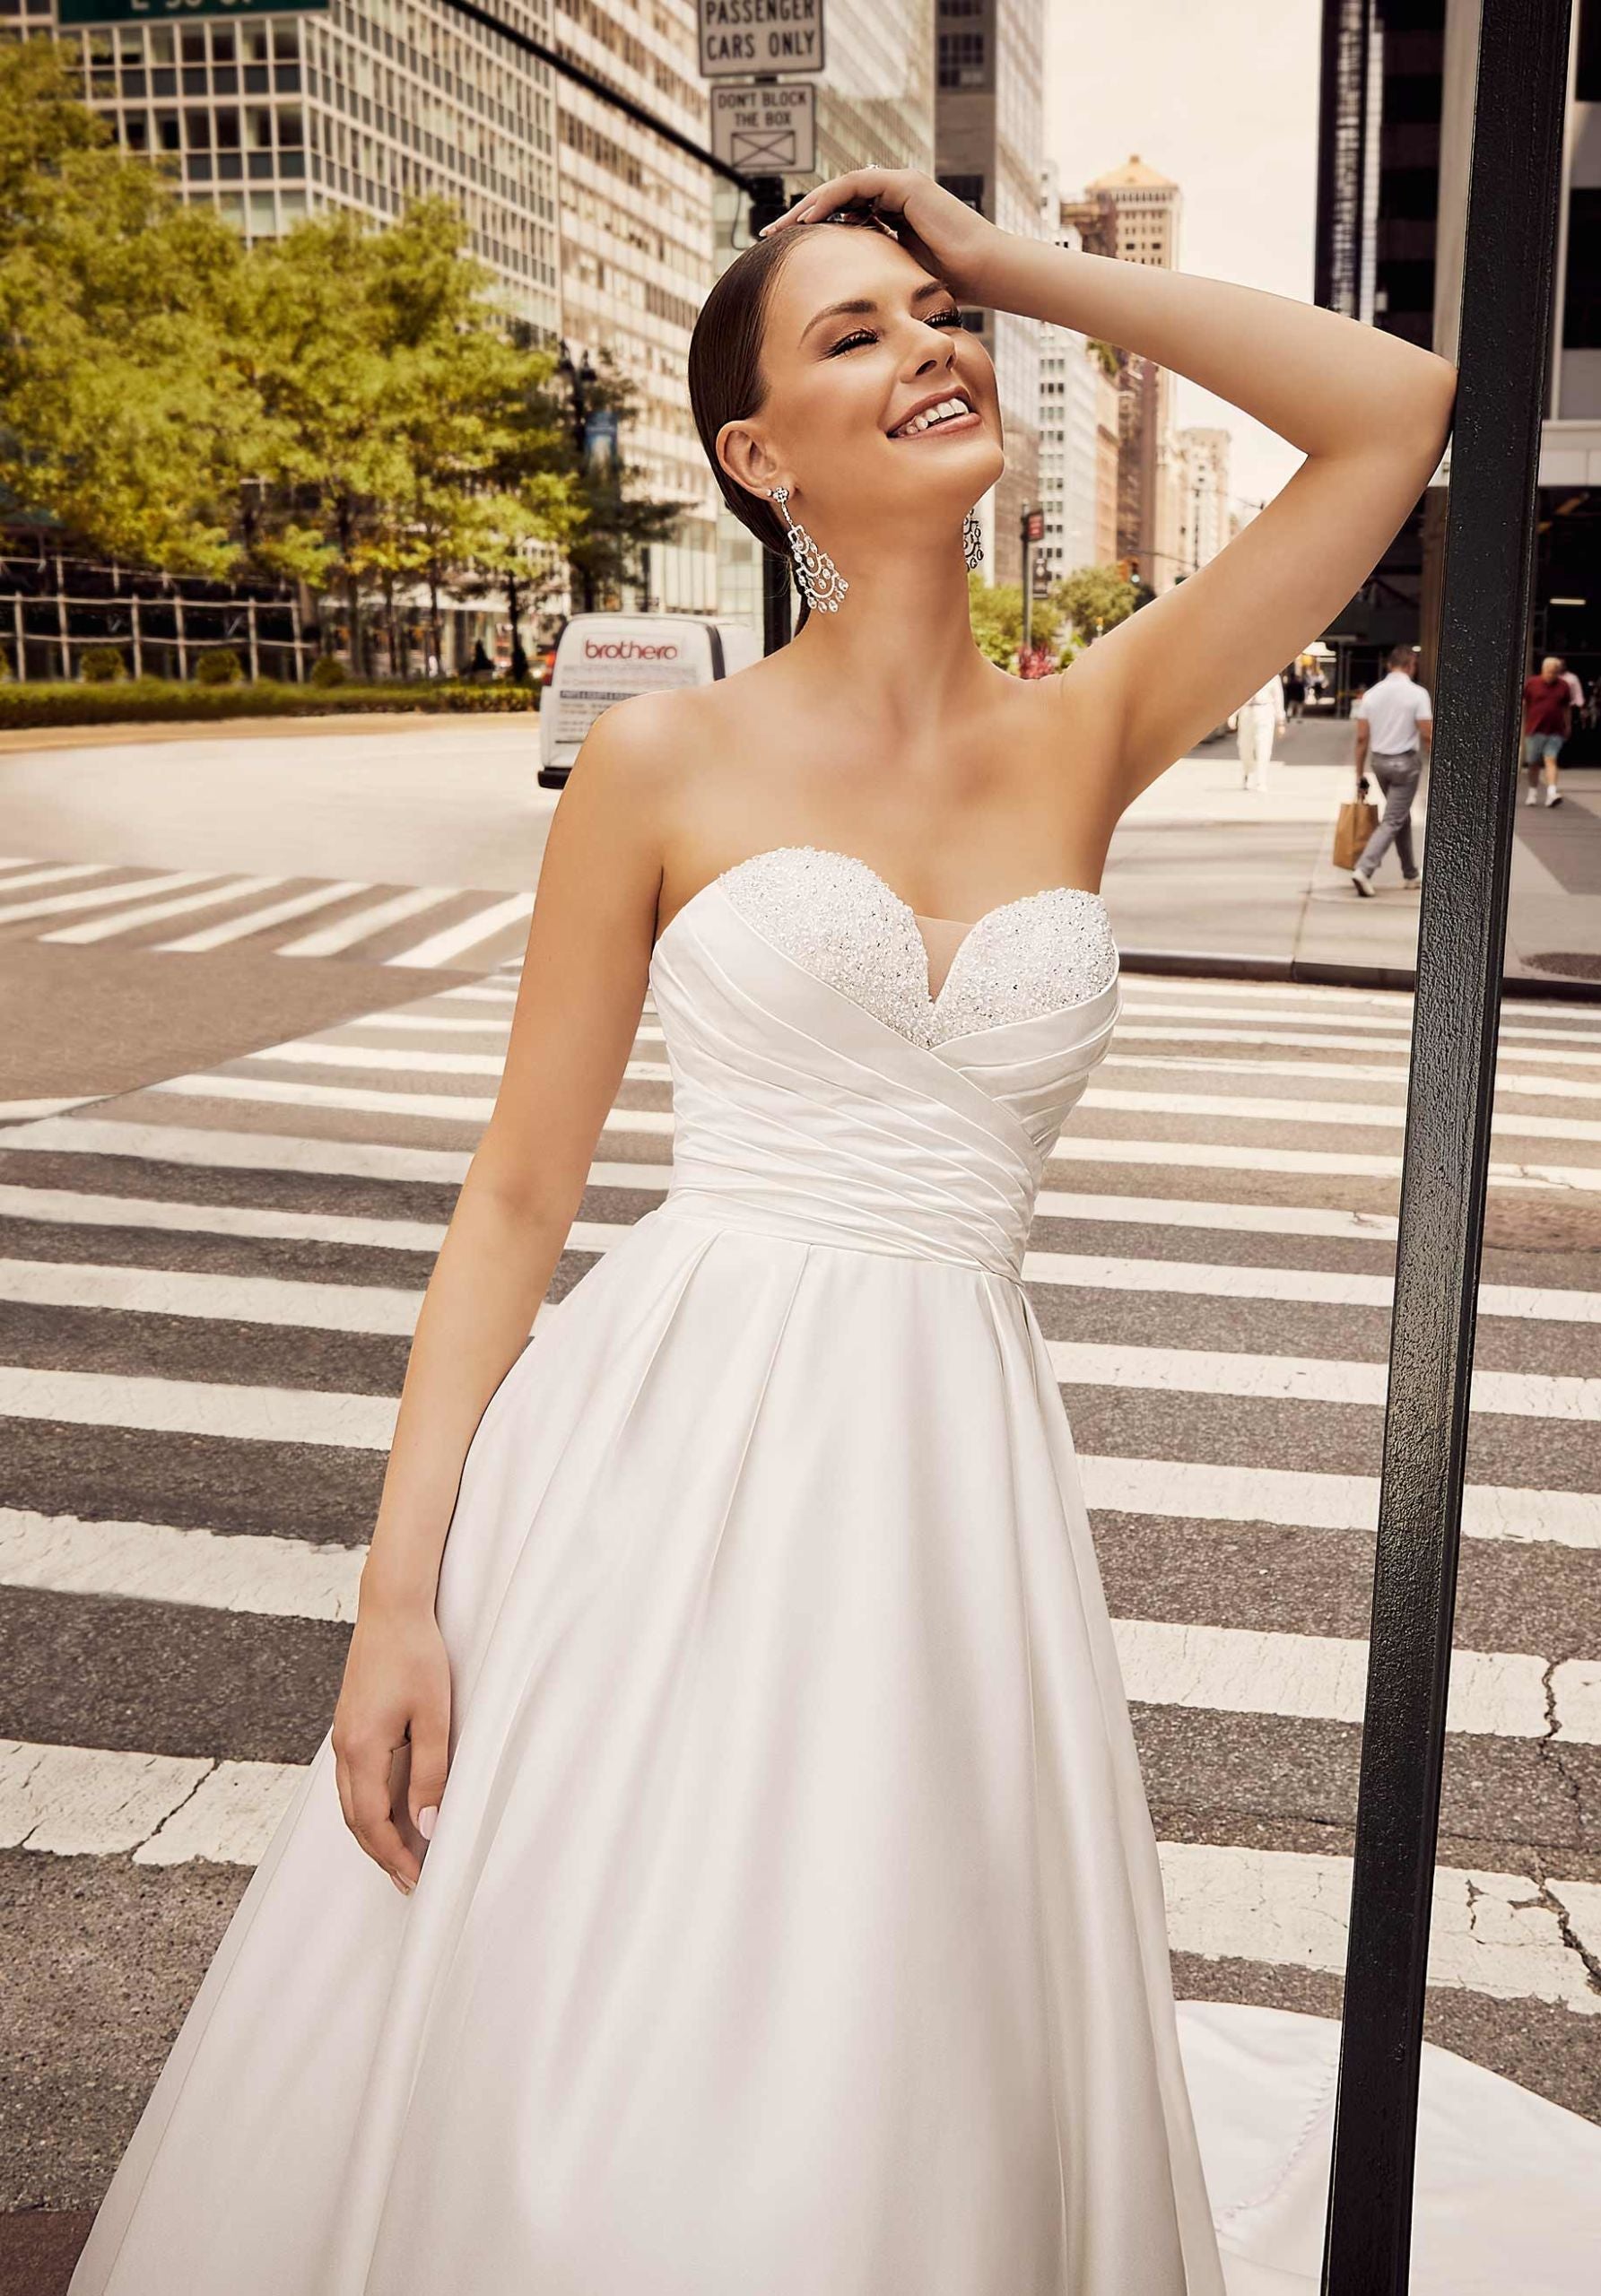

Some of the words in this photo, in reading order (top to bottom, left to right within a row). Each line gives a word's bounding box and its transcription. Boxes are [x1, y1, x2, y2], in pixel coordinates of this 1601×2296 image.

[705, 0, 815, 25] PASSENGER
[706, 33, 755, 60] CARS
[769, 30, 814, 57] ONLY
[718, 92, 756, 109] DON'T
[762, 91, 806, 107] BLOCK
[735, 112, 759, 127] THE
[765, 111, 791, 126] BOX
